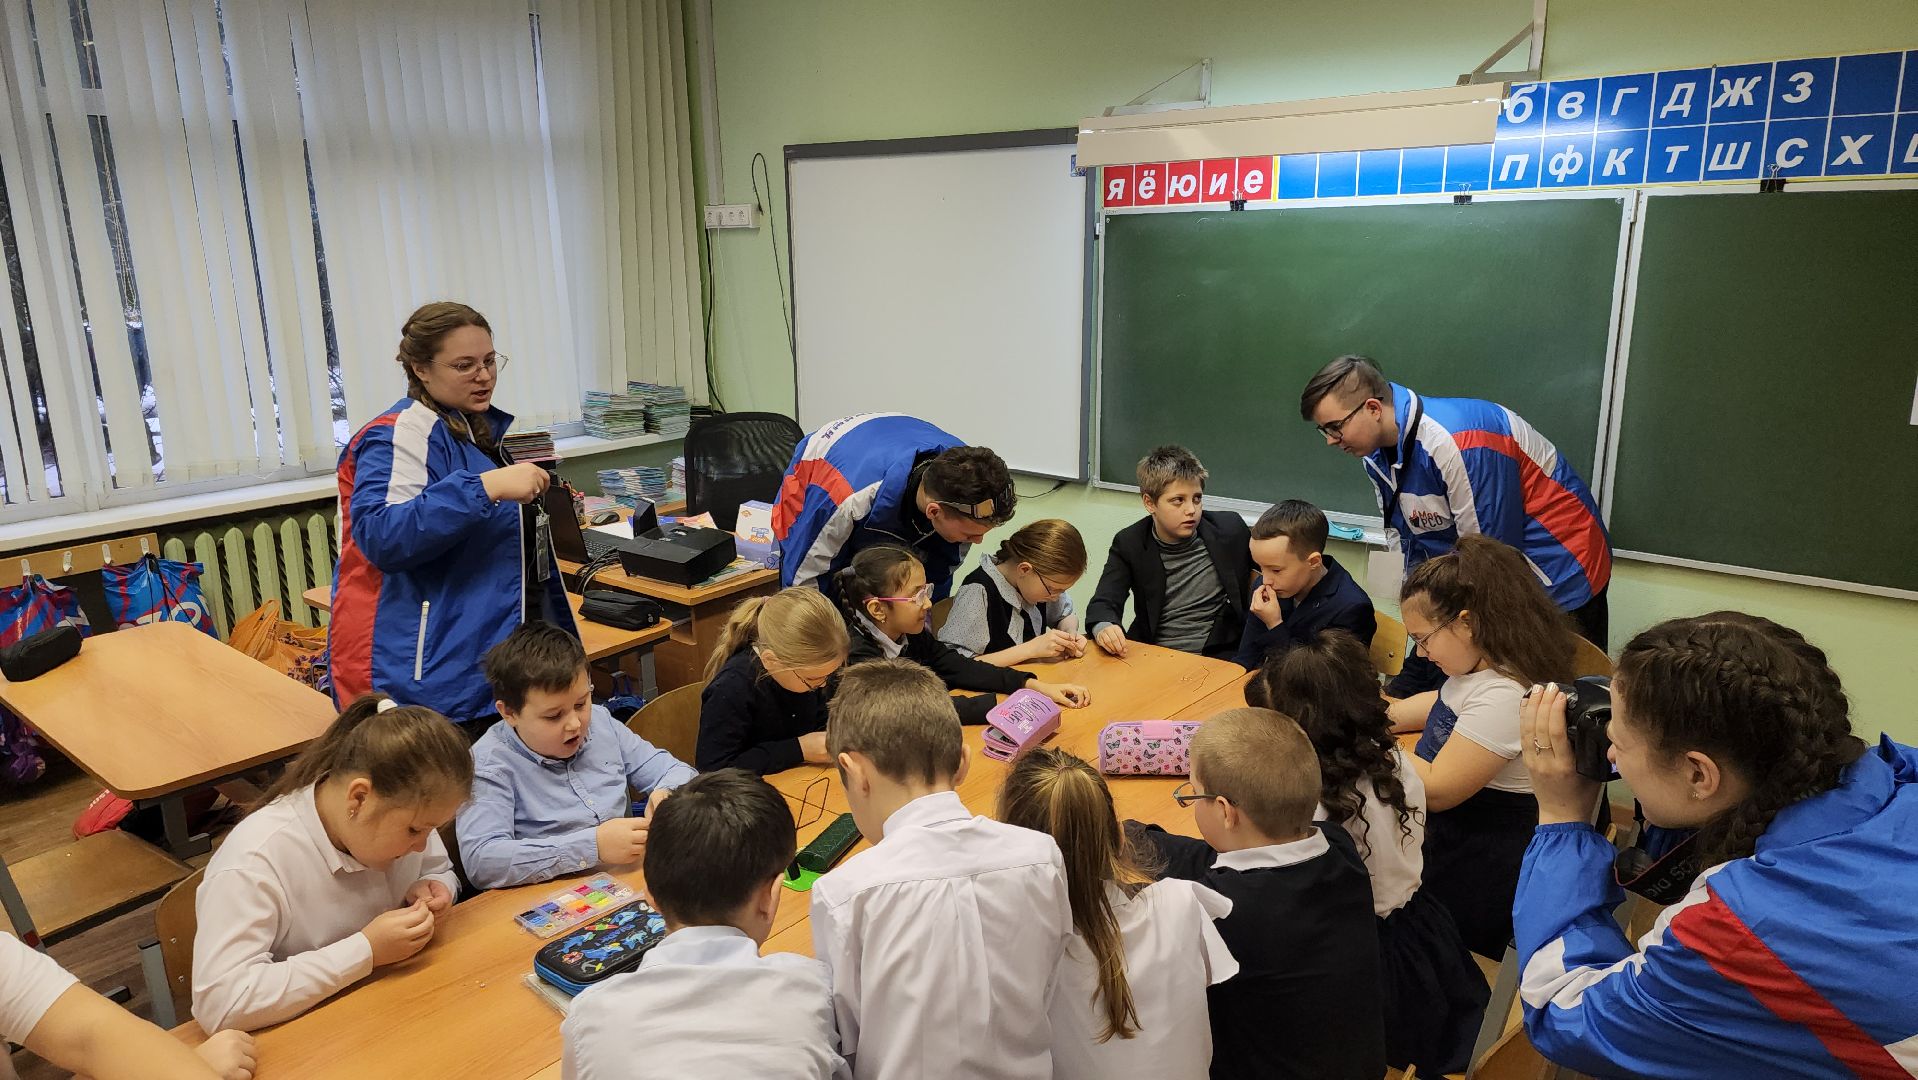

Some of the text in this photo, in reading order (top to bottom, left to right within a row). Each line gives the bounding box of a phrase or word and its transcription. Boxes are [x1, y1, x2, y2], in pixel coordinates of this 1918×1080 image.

[1505, 84, 1538, 124] б
[1557, 91, 1586, 120] в
[1659, 82, 1697, 119] д
[1710, 75, 1763, 109] ж
[1548, 144, 1584, 183] ф
[1107, 169, 1264, 201] я ё ю и е
